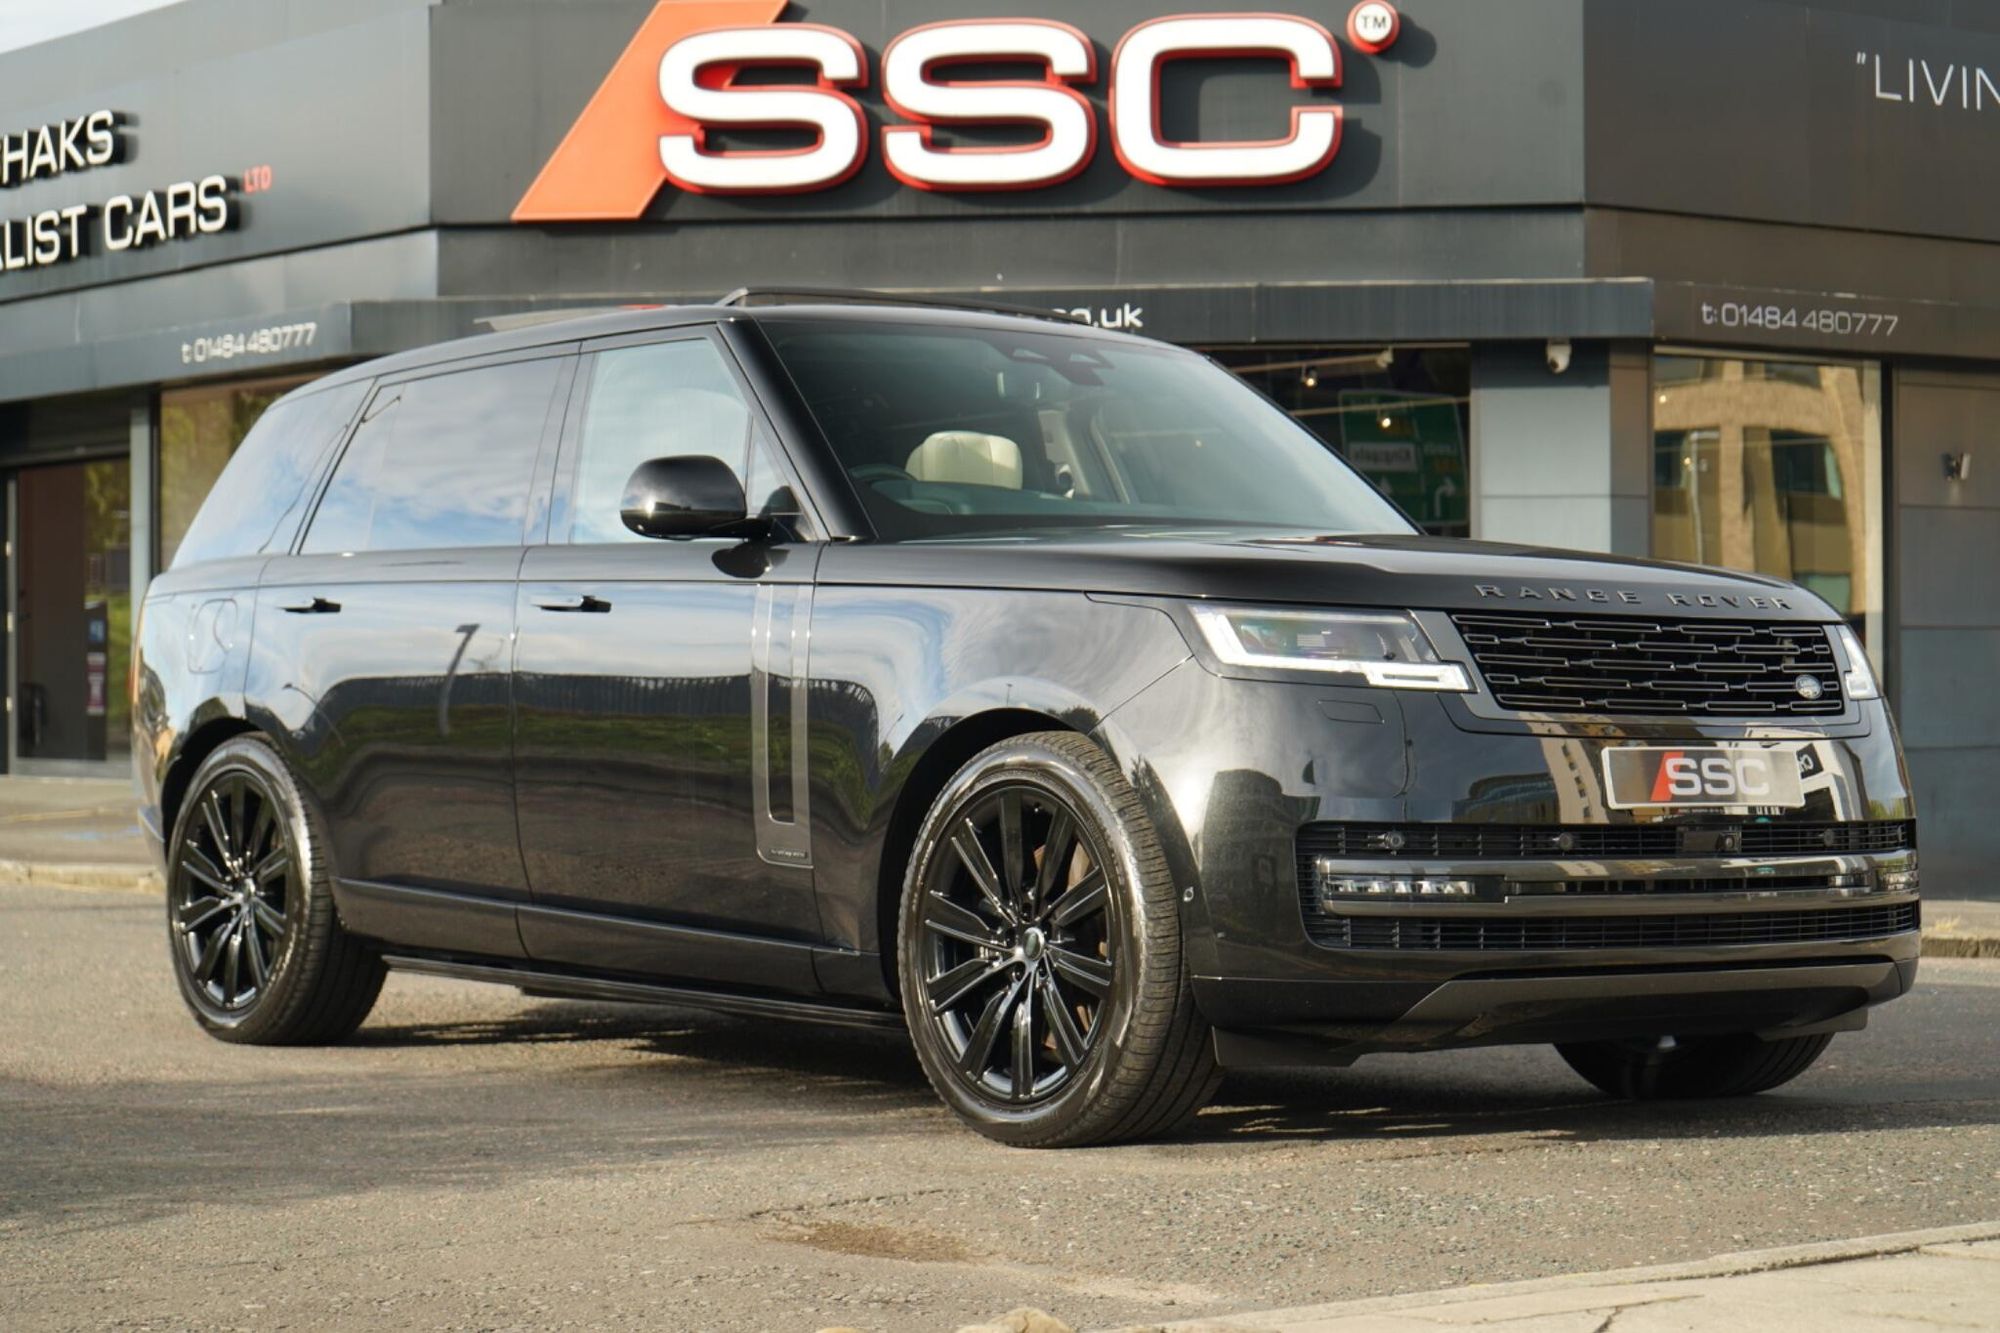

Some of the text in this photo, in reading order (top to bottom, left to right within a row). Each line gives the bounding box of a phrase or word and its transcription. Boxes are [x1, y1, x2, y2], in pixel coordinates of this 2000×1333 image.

[1361, 15, 1386, 29] TM
[659, 14, 1342, 191] SSC
[0, 109, 114, 184] HAKS
[243, 164, 272, 193] LTD
[0, 174, 228, 271] LIST CARS
[1475, 584, 1792, 610] RANGE ROVER
[1666, 758, 1769, 795] SSC
